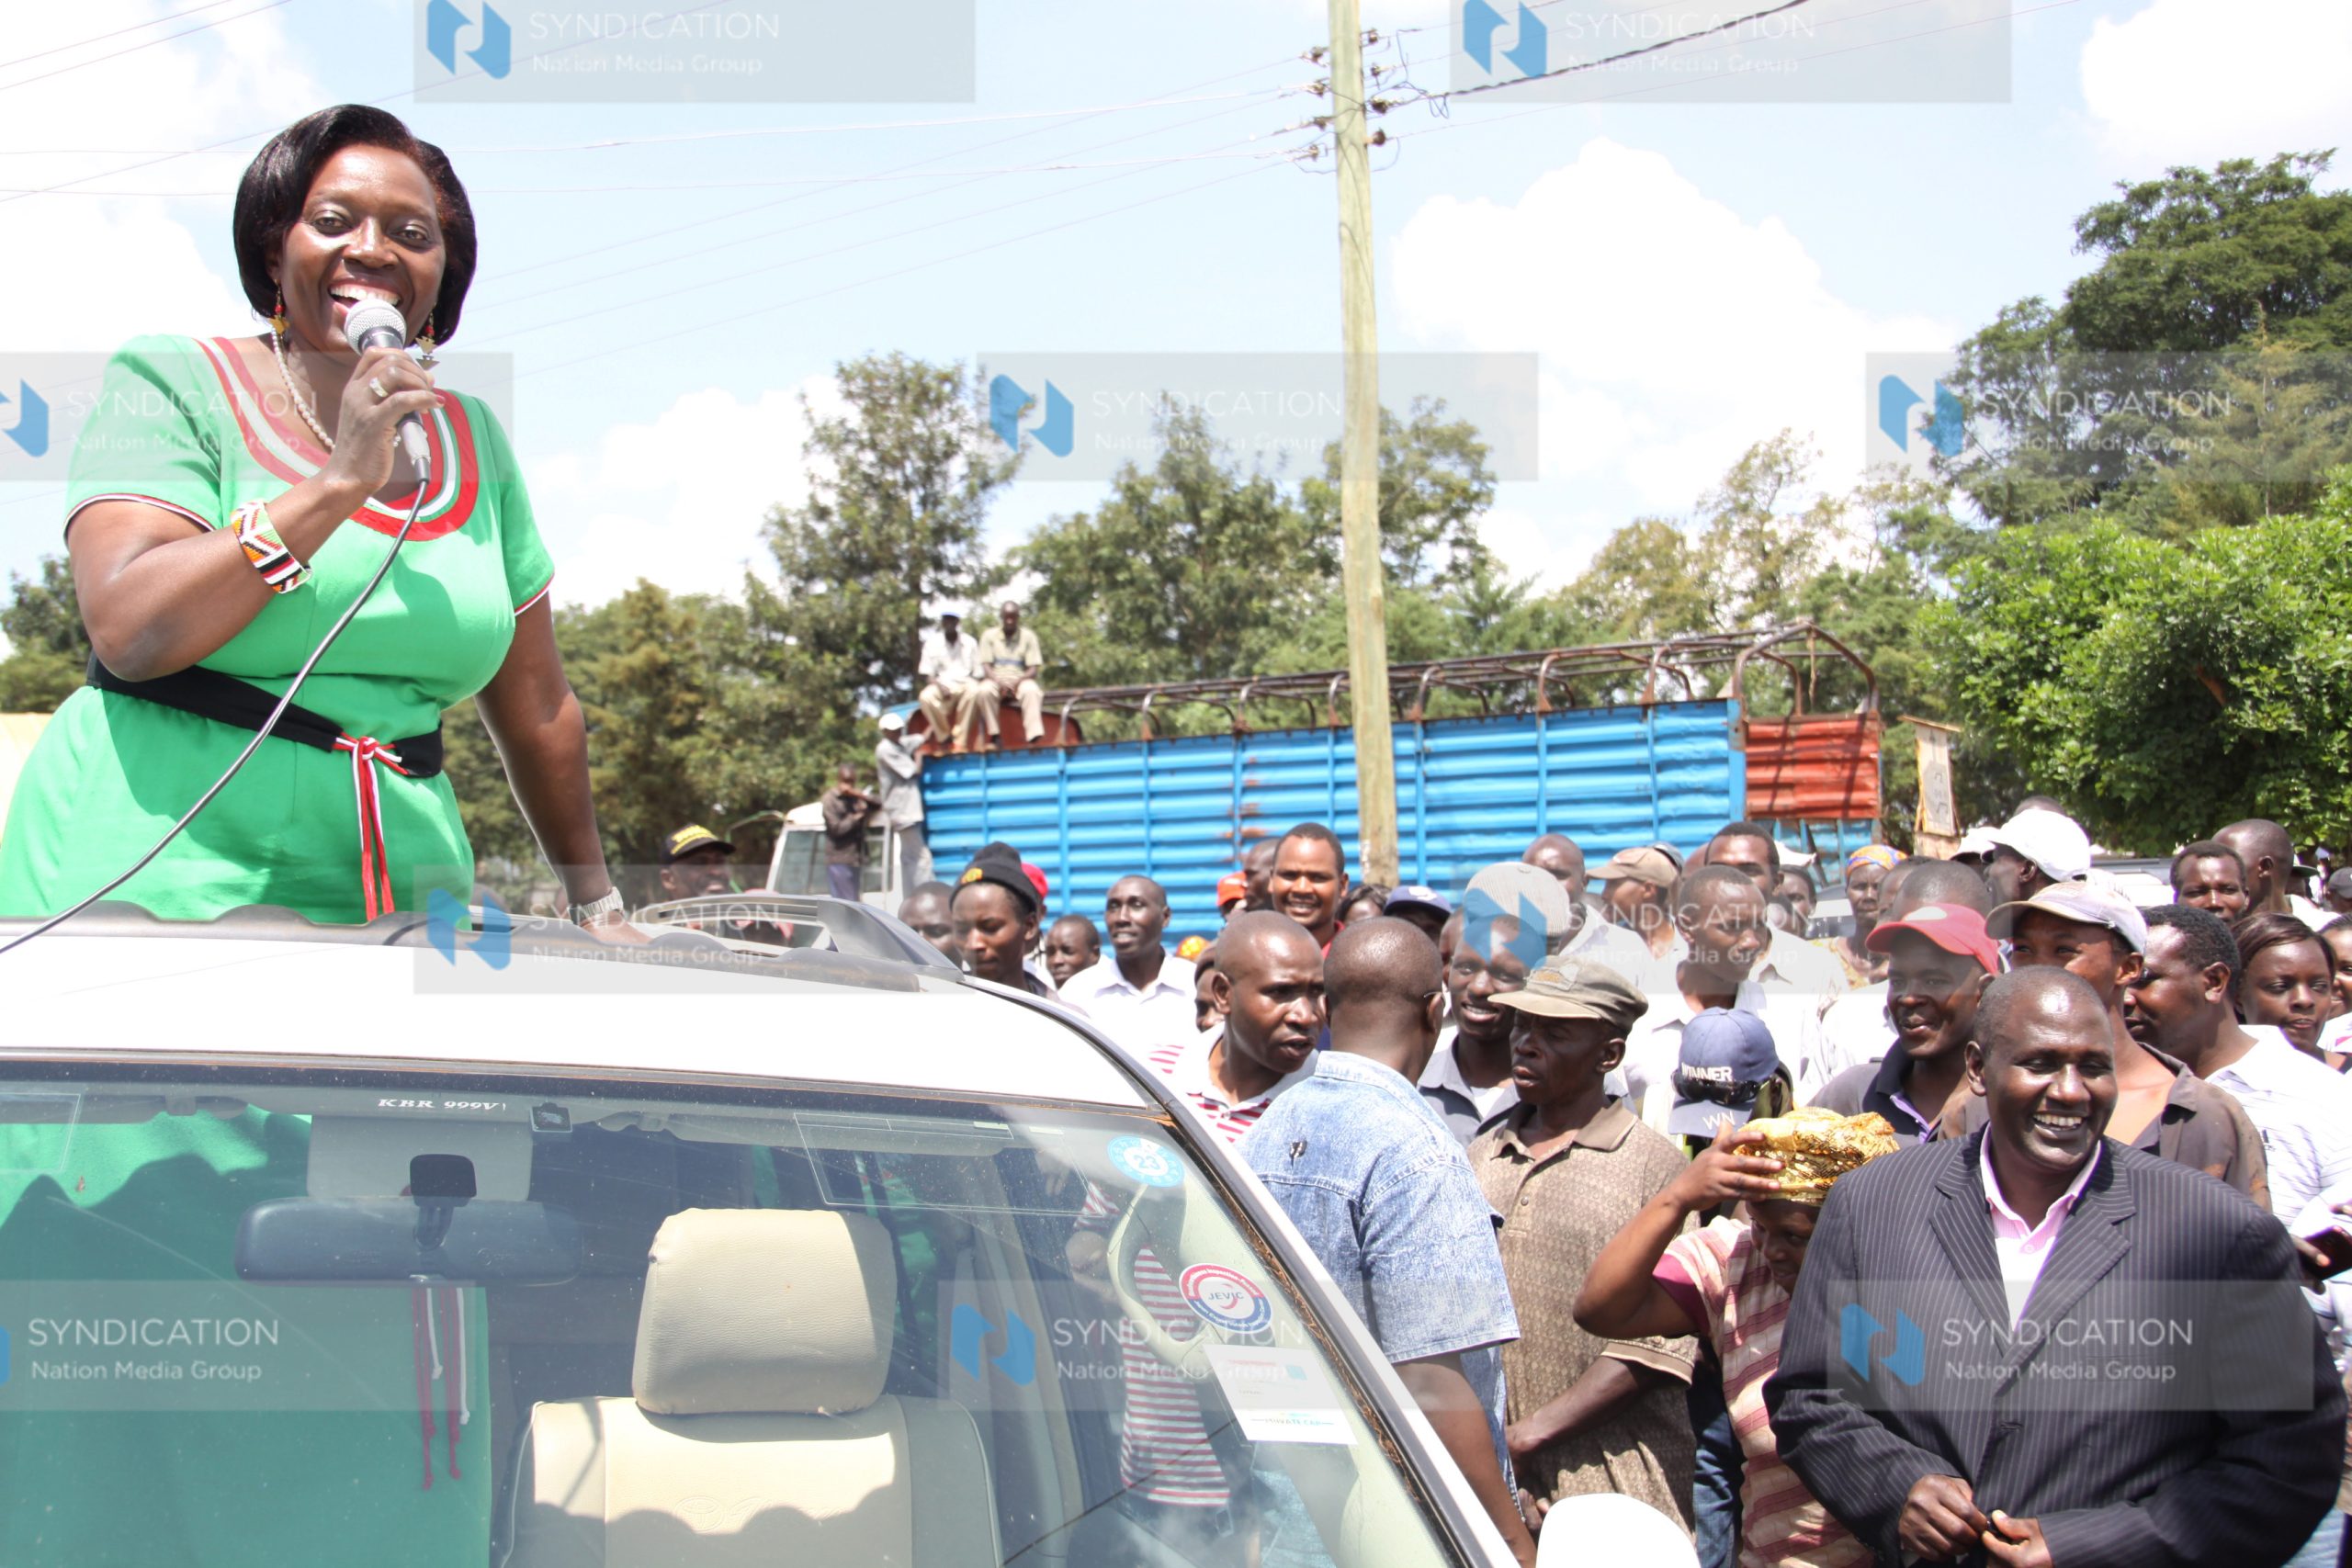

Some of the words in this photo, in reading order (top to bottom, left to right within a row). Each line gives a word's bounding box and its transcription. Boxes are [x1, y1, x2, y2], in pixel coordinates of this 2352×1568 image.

[1681, 1062, 1733, 1082] WINNER
[378, 1099, 435, 1108] KBR
[1133, 1154, 1161, 1170] 23
[1208, 1292, 1244, 1301] JEVIC
